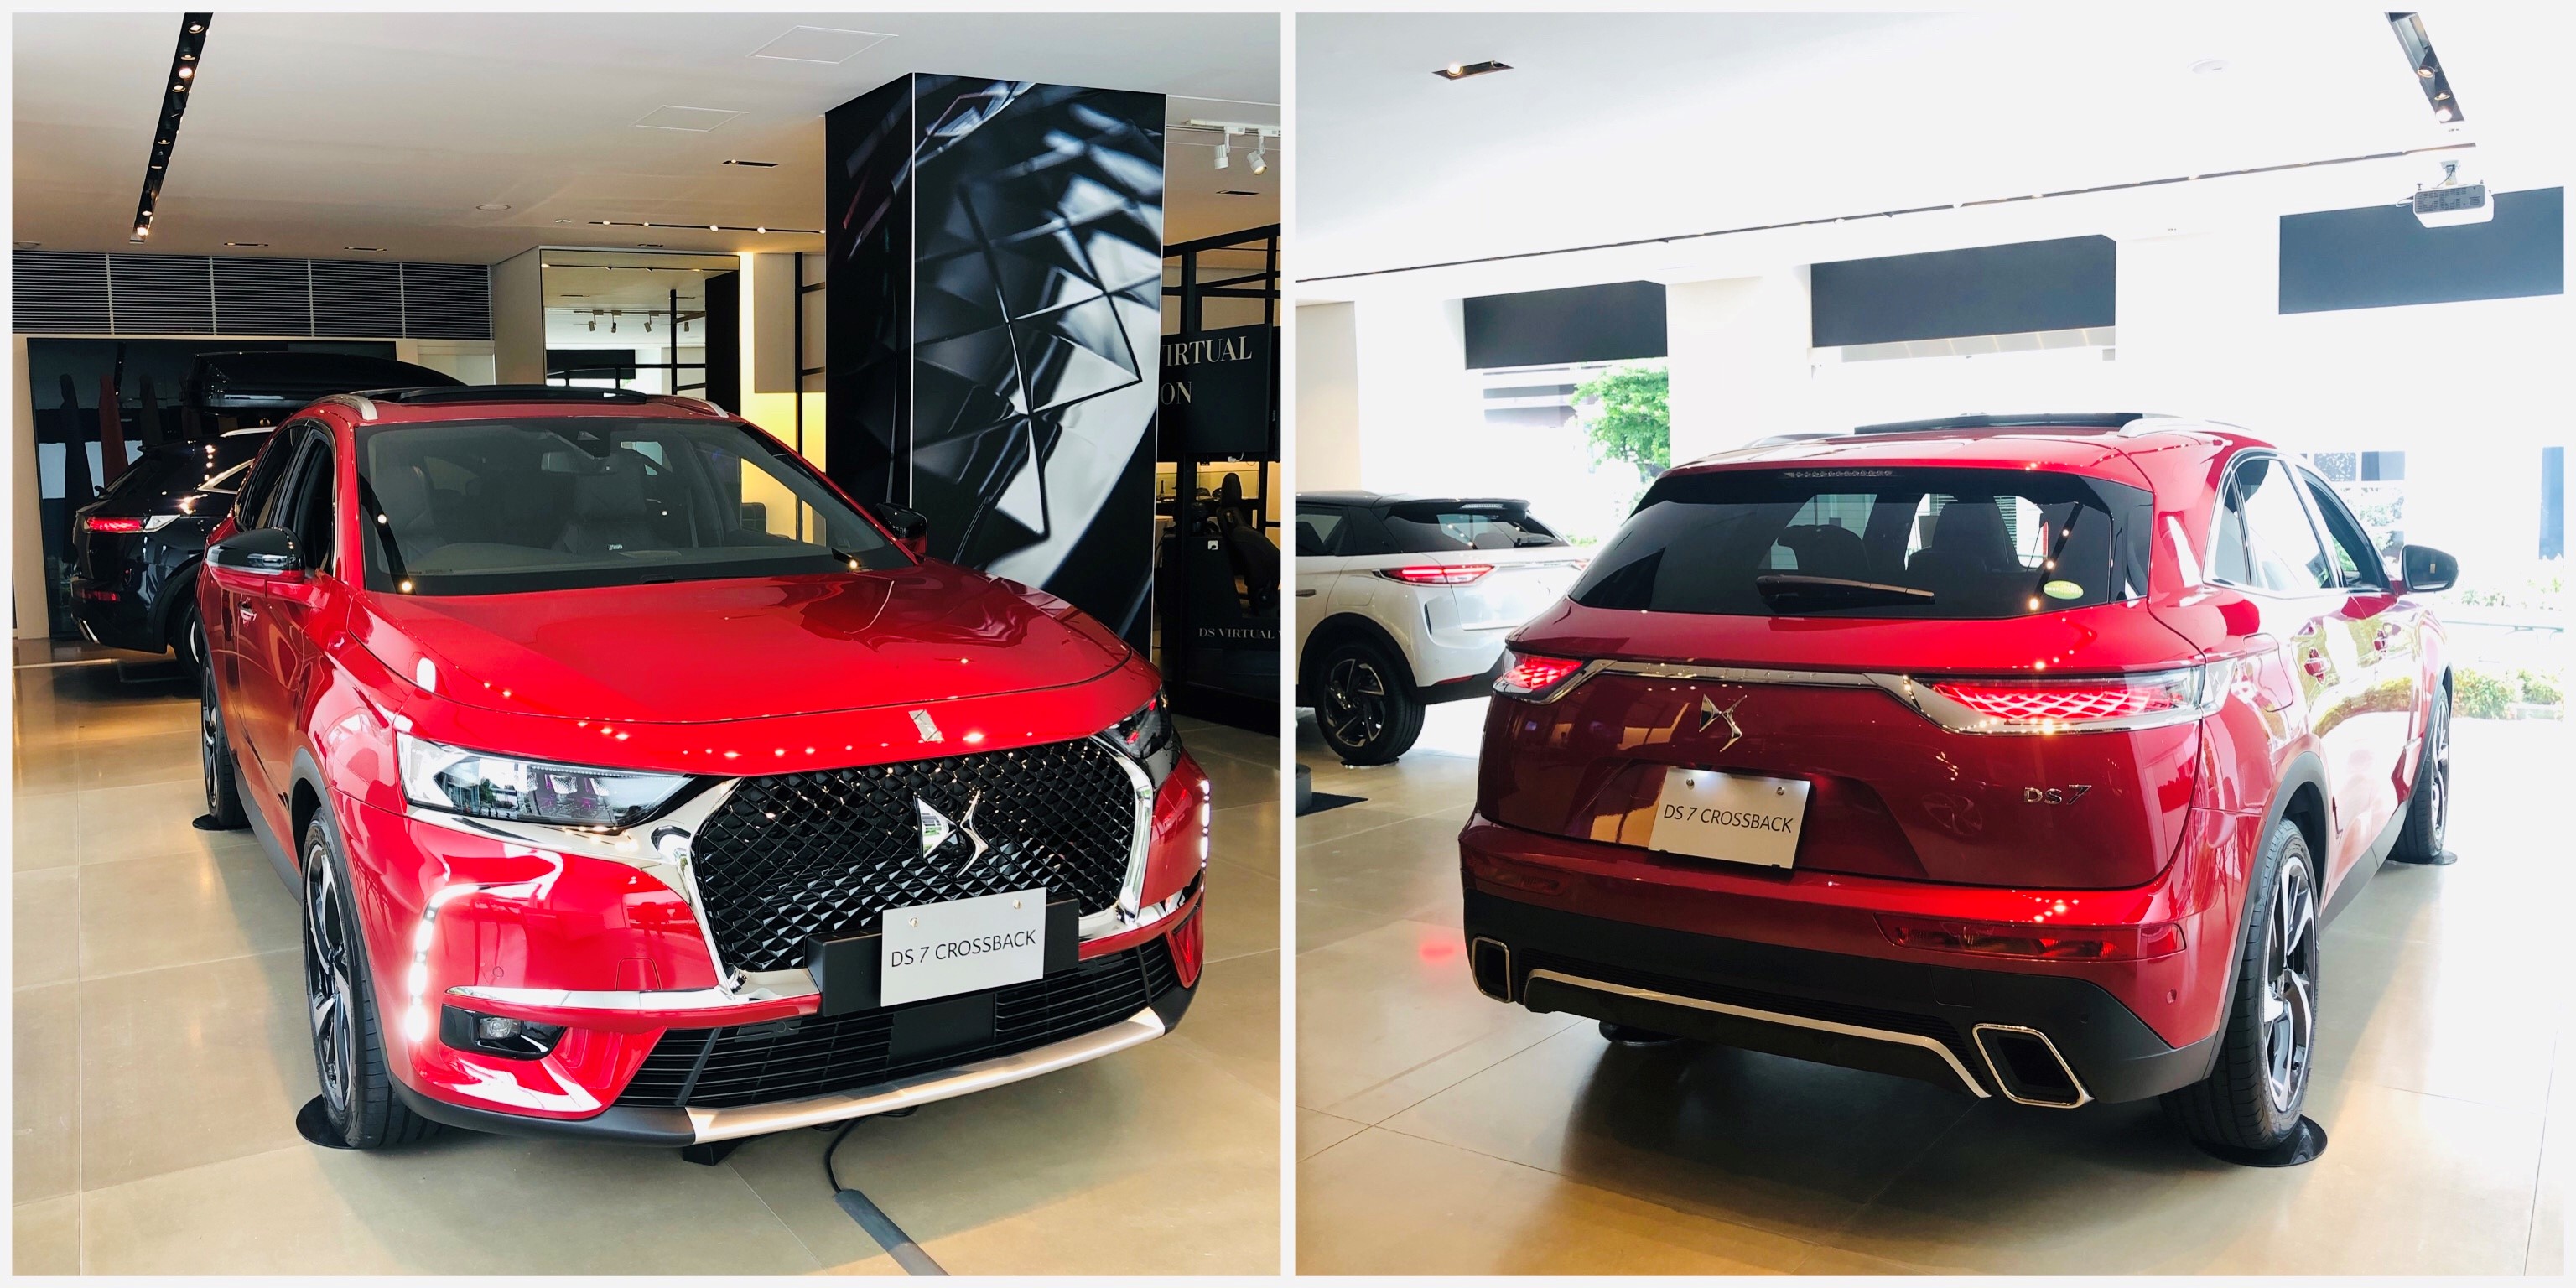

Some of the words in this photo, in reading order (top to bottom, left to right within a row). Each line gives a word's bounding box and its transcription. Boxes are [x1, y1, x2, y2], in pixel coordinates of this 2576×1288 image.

[1199, 628, 1215, 638] DS
[1218, 628, 1275, 639] VIRTUAL
[2023, 787, 2063, 804] DS
[2066, 784, 2092, 805] 7
[1664, 804, 1684, 820] DS
[1686, 807, 1698, 821] 7
[1701, 808, 1794, 834] CROSSBACK
[891, 948, 914, 968] DS
[920, 946, 930, 963] 7
[935, 929, 1036, 960] CROSSBACK
